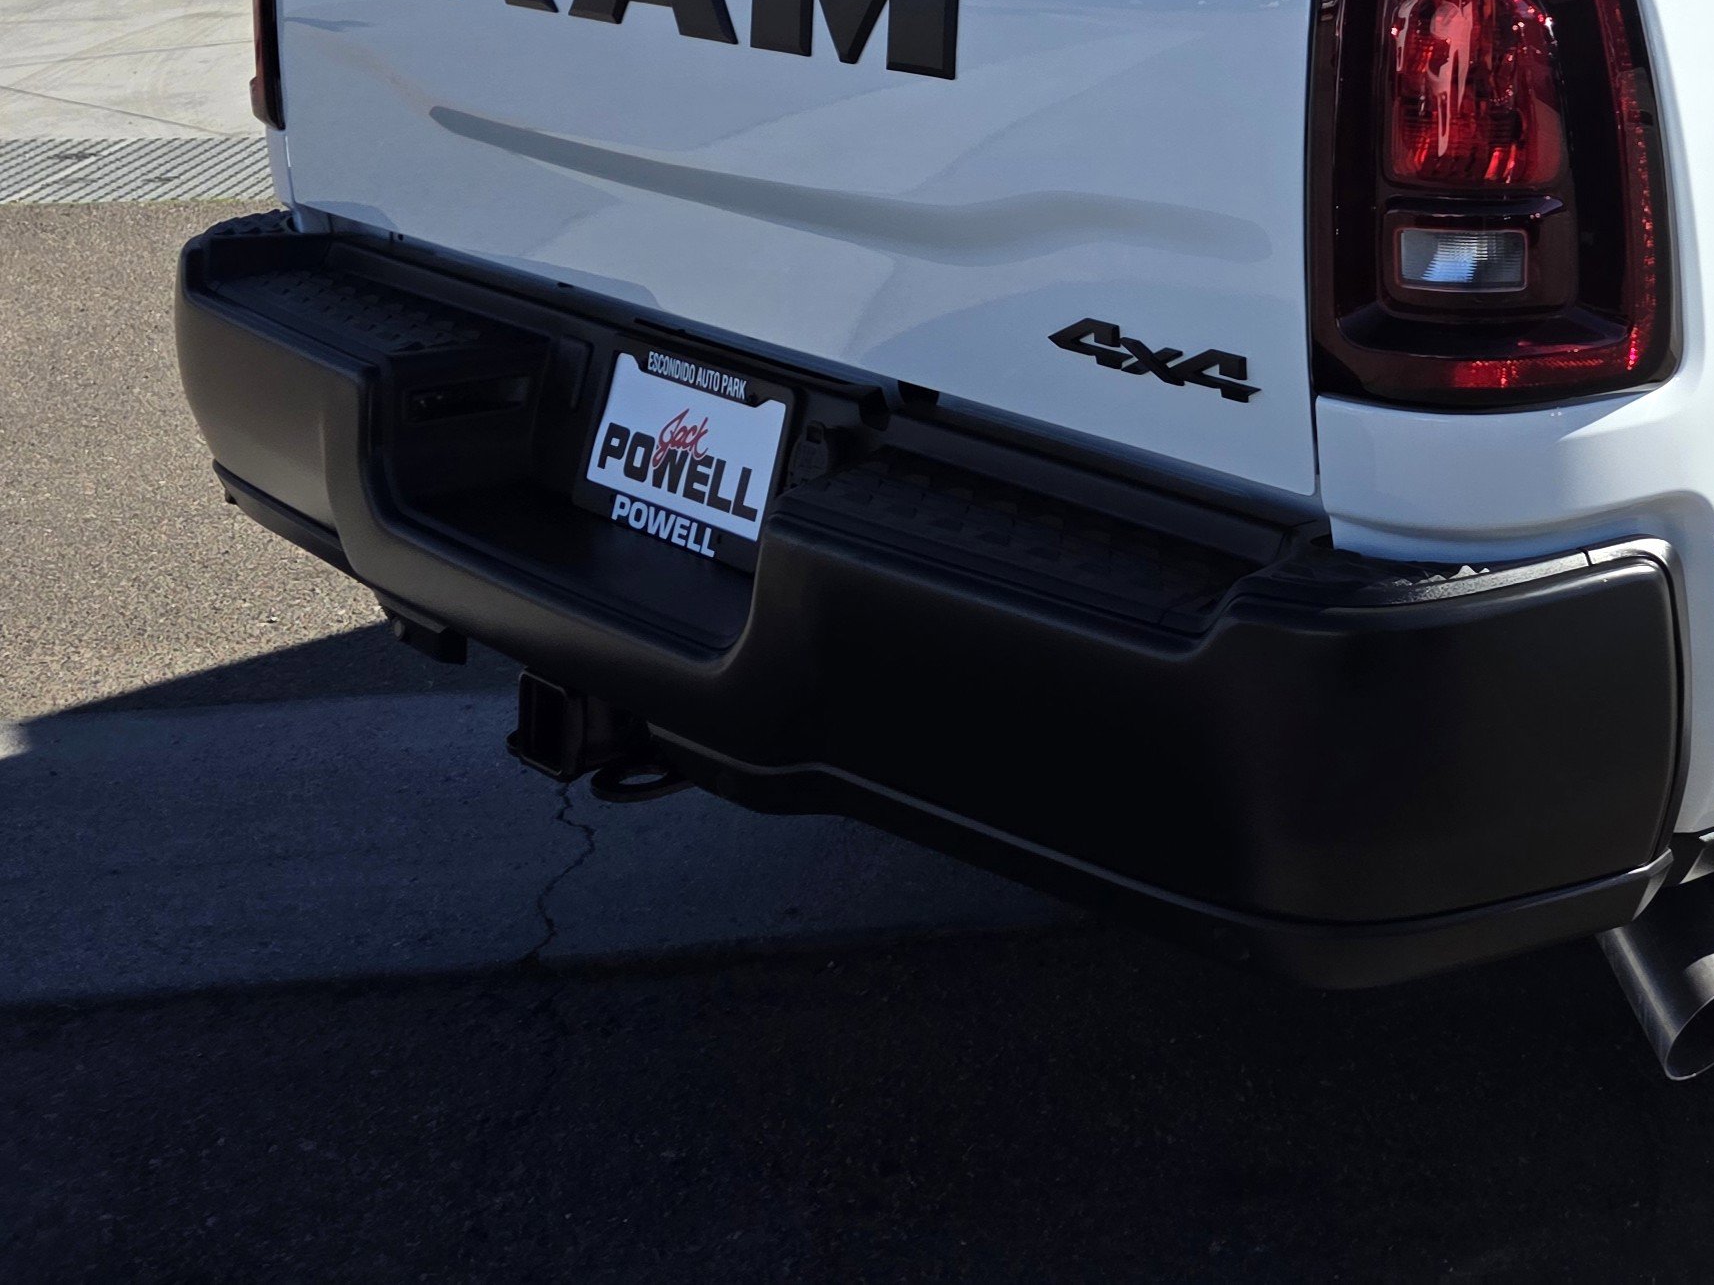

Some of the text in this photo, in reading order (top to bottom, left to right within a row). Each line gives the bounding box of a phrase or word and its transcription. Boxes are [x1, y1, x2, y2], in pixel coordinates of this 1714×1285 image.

[648, 351, 747, 400] ESCONDIDO AUTO PARK
[652, 409, 709, 469] Jack
[597, 422, 758, 523] POWELL
[611, 494, 716, 558] POWELL
